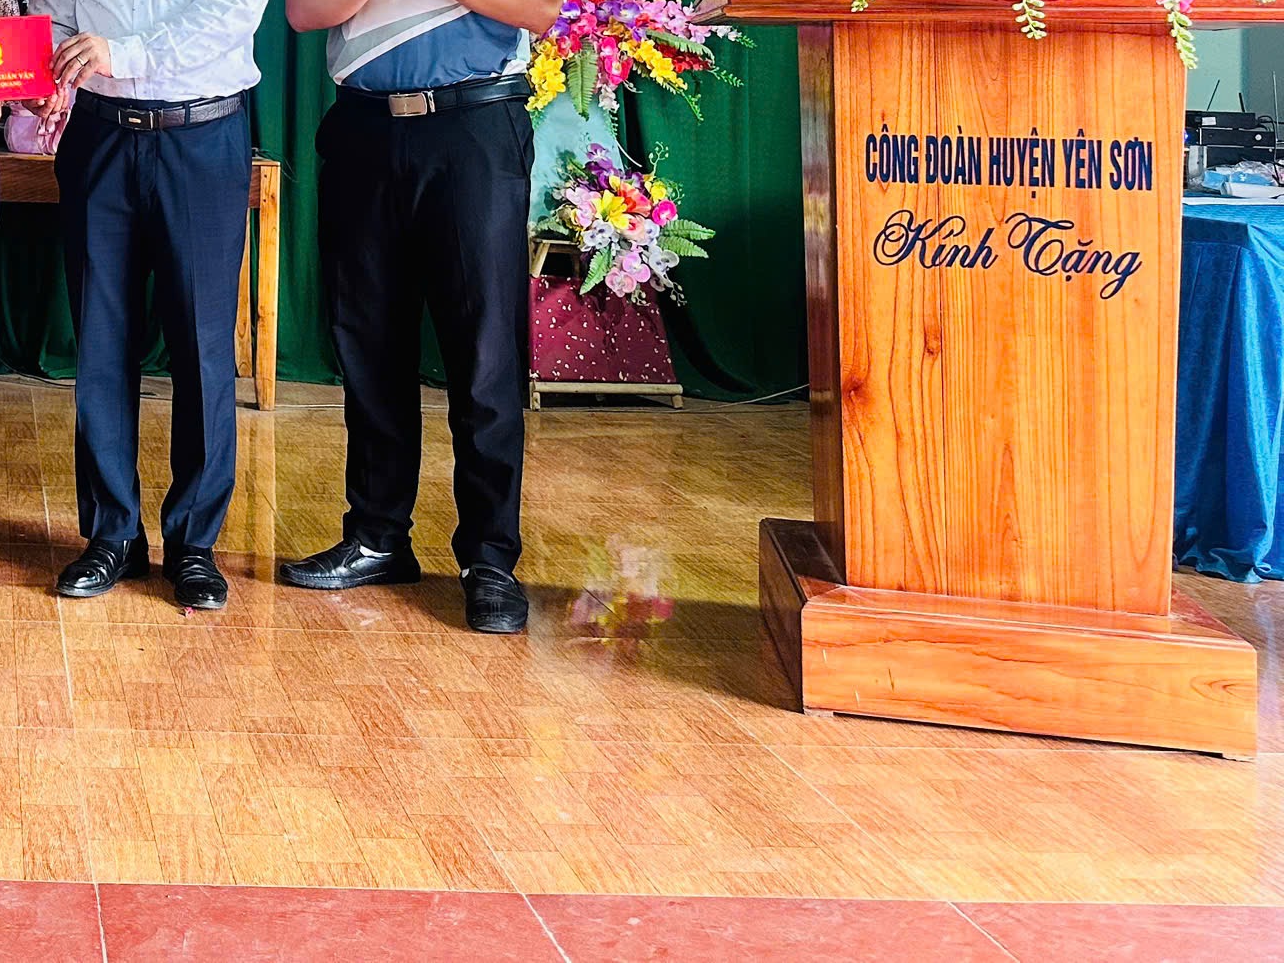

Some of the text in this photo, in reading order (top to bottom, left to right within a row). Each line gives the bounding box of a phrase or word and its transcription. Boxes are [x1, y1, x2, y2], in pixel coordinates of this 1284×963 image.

[866, 124, 1153, 199] CÔNG ĐOÀN HUYỆN YÊN SƠN
[873, 209, 1142, 300] Kính Tặng
